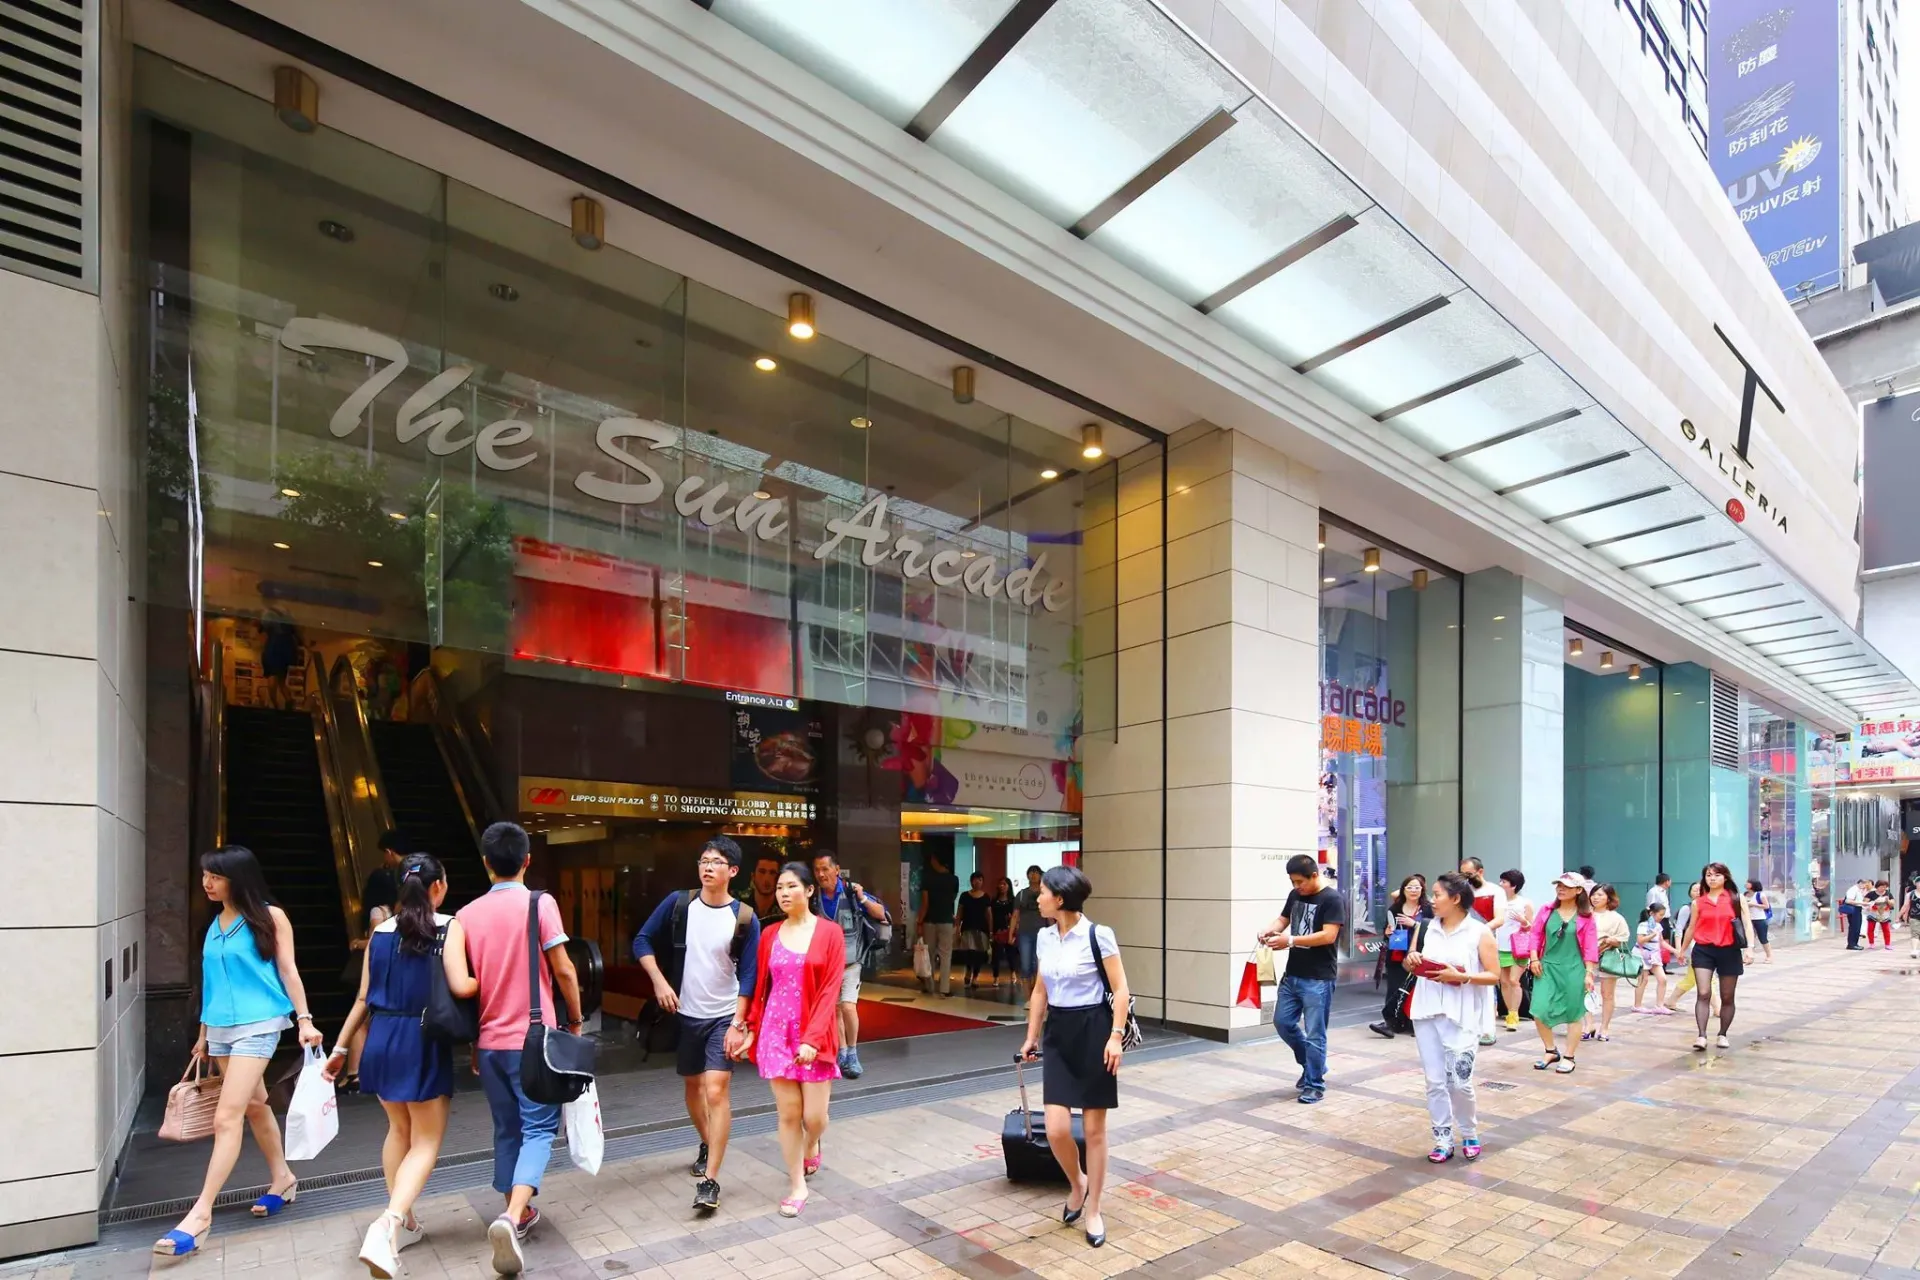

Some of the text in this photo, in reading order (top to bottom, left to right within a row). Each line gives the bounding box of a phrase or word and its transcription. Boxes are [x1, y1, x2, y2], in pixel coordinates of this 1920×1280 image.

[1737, 44, 1778, 78] 防塵
[1728, 115, 1789, 158] 防刮花
[1727, 166, 1790, 208] UV
[1713, 322, 1786, 470] T
[280, 317, 1073, 612] The Sun Arcade
[1680, 418, 1788, 534] GALLERIA
[726, 691, 783, 707] Entrance 入口
[617, 797, 645, 805] PLAZA
[664, 794, 678, 803] TO
[681, 796, 715, 806] OFFICE
[718, 797, 739, 807] LIFT
[741, 799, 772, 808] LOBBY
[664, 804, 678, 812] TO
[680, 805, 728, 815] SHOPPING
[730, 809, 767, 817] ARCADE
